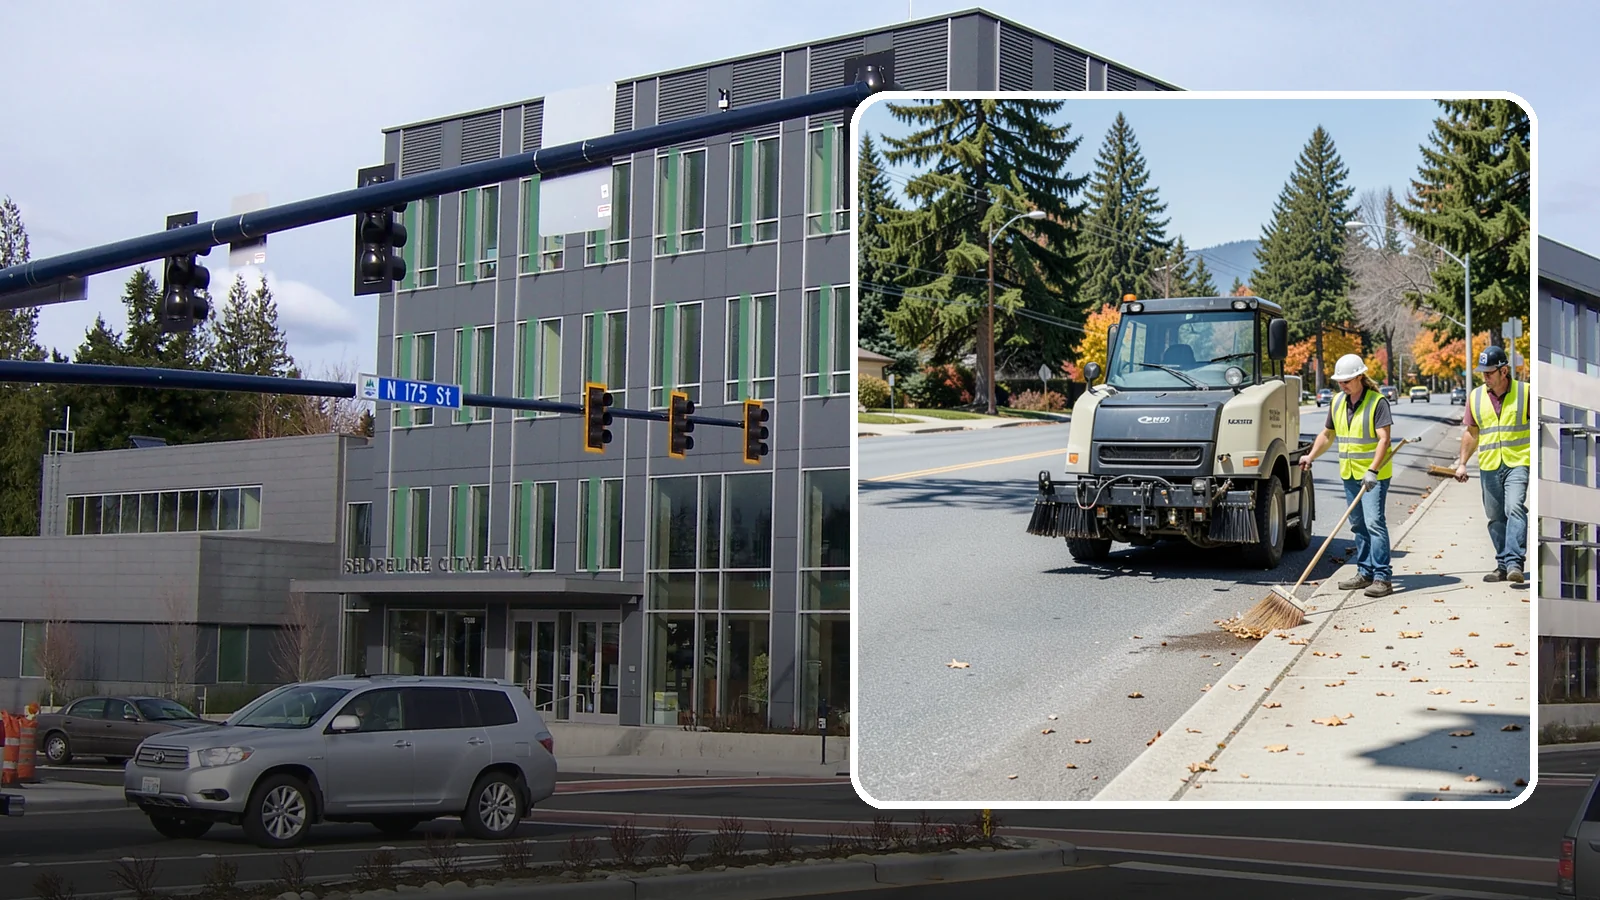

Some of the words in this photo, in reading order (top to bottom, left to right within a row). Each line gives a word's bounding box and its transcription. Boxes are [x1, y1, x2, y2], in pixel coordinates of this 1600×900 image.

[387, 380, 396, 400] N
[405, 382, 428, 403] 175
[436, 386, 451, 406] St
[344, 557, 432, 574] SHORELINE
[438, 556, 475, 572] CITY
[483, 555, 526, 572] HALL
